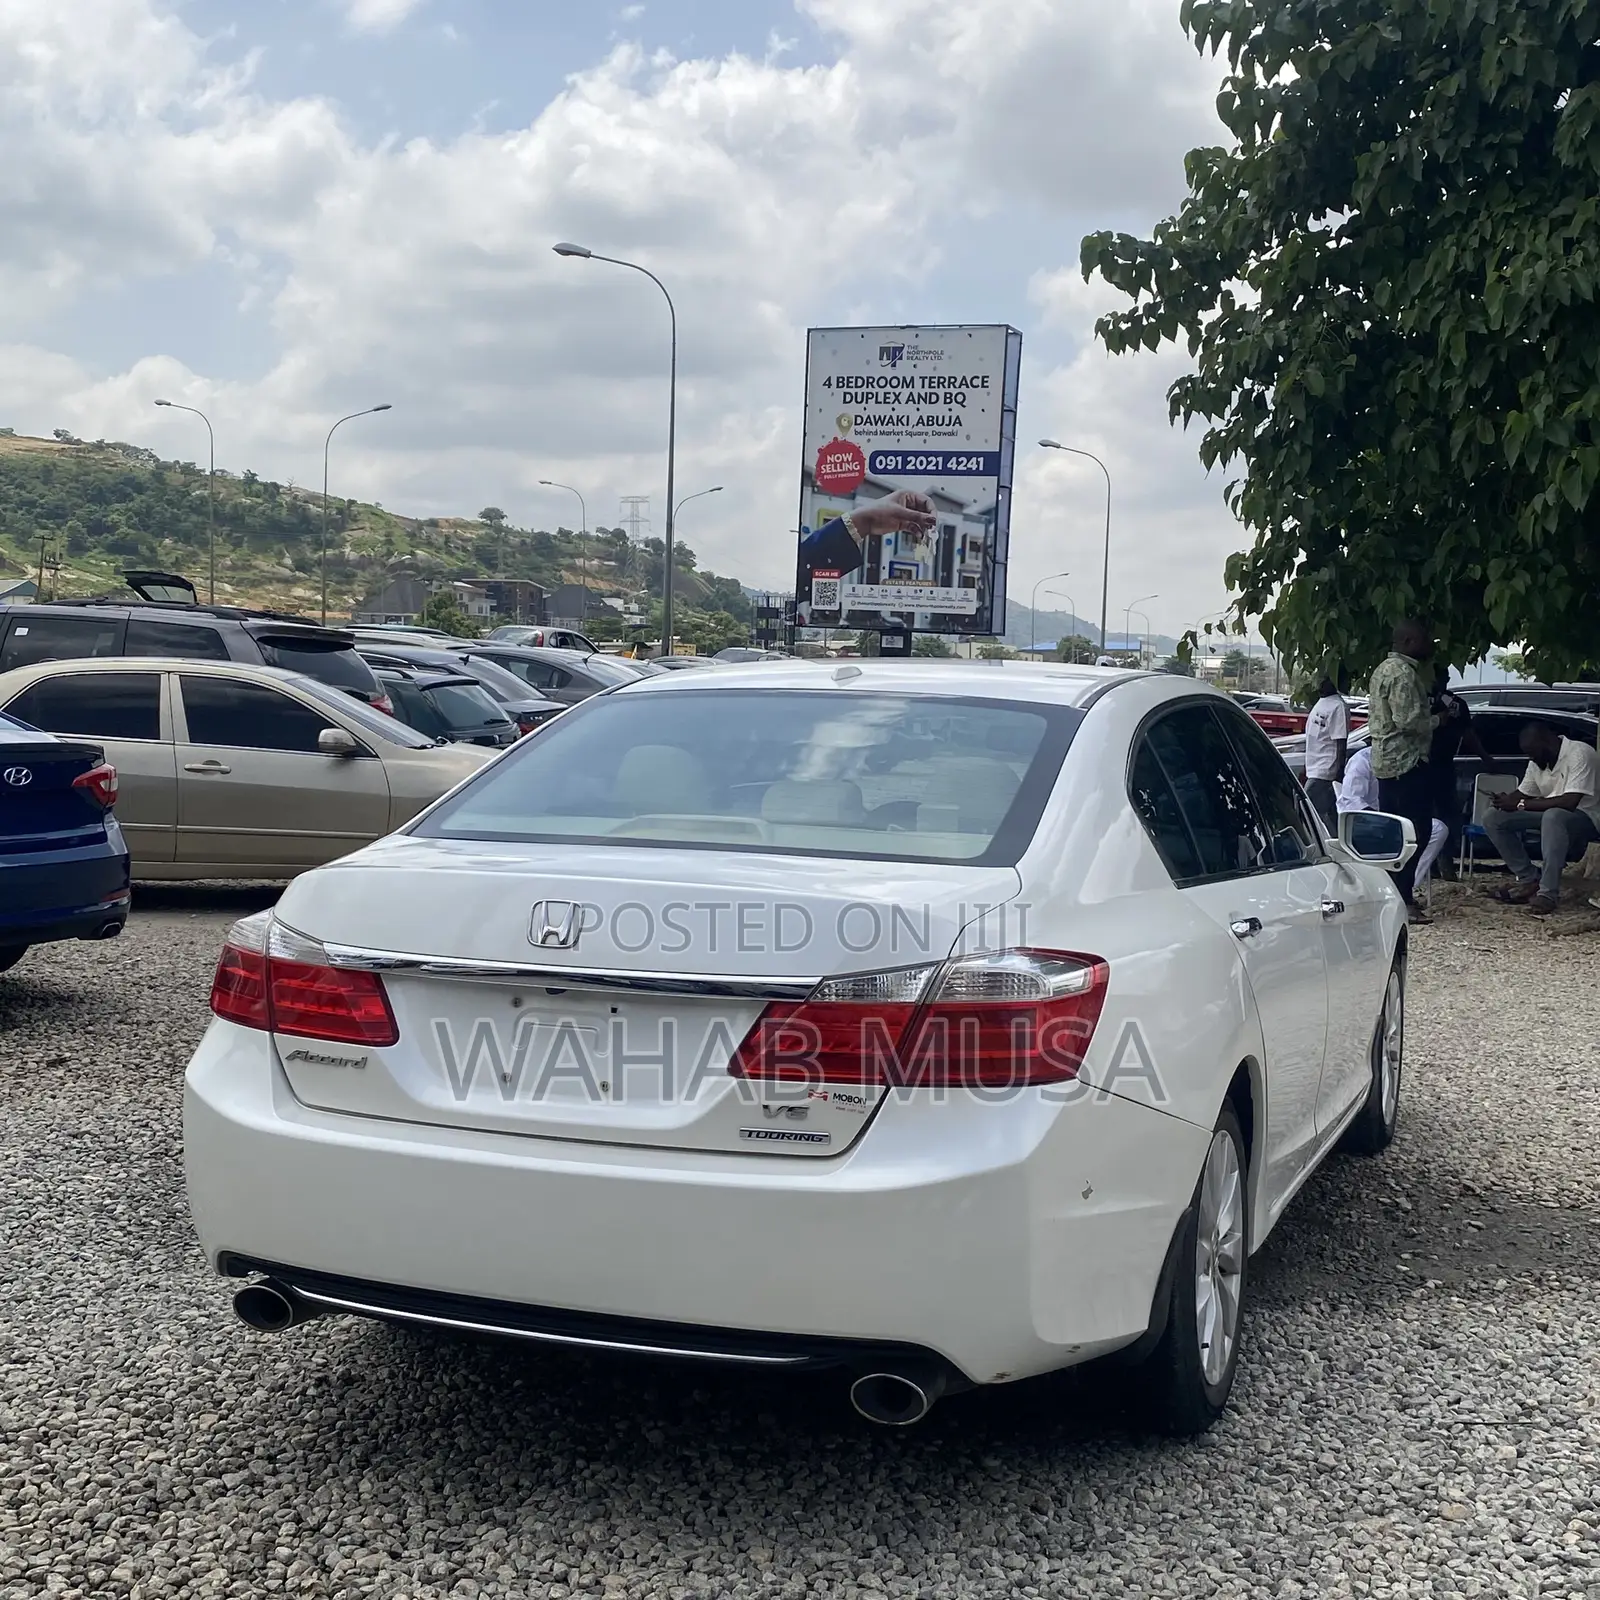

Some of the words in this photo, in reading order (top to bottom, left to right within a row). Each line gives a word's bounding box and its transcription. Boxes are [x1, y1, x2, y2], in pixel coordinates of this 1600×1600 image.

[822, 376, 832, 389] 4
[836, 376, 914, 389] BEDROOM
[919, 376, 990, 389] TERRACE
[842, 392, 901, 405] DUPLEX
[904, 392, 940, 405] AND
[943, 392, 967, 408] BQ
[904, 430, 931, 438] Square,
[826, 453, 853, 464] NOW
[875, 456, 901, 470] 091
[905, 456, 943, 471] 2021
[947, 457, 984, 471] 4241
[820, 461, 860, 474] SELLING
[285, 1049, 368, 1069] Accord
[832, 1092, 867, 1105] MOBON
[762, 1104, 810, 1120] V6
[747, 1130, 824, 1143] TOURING
